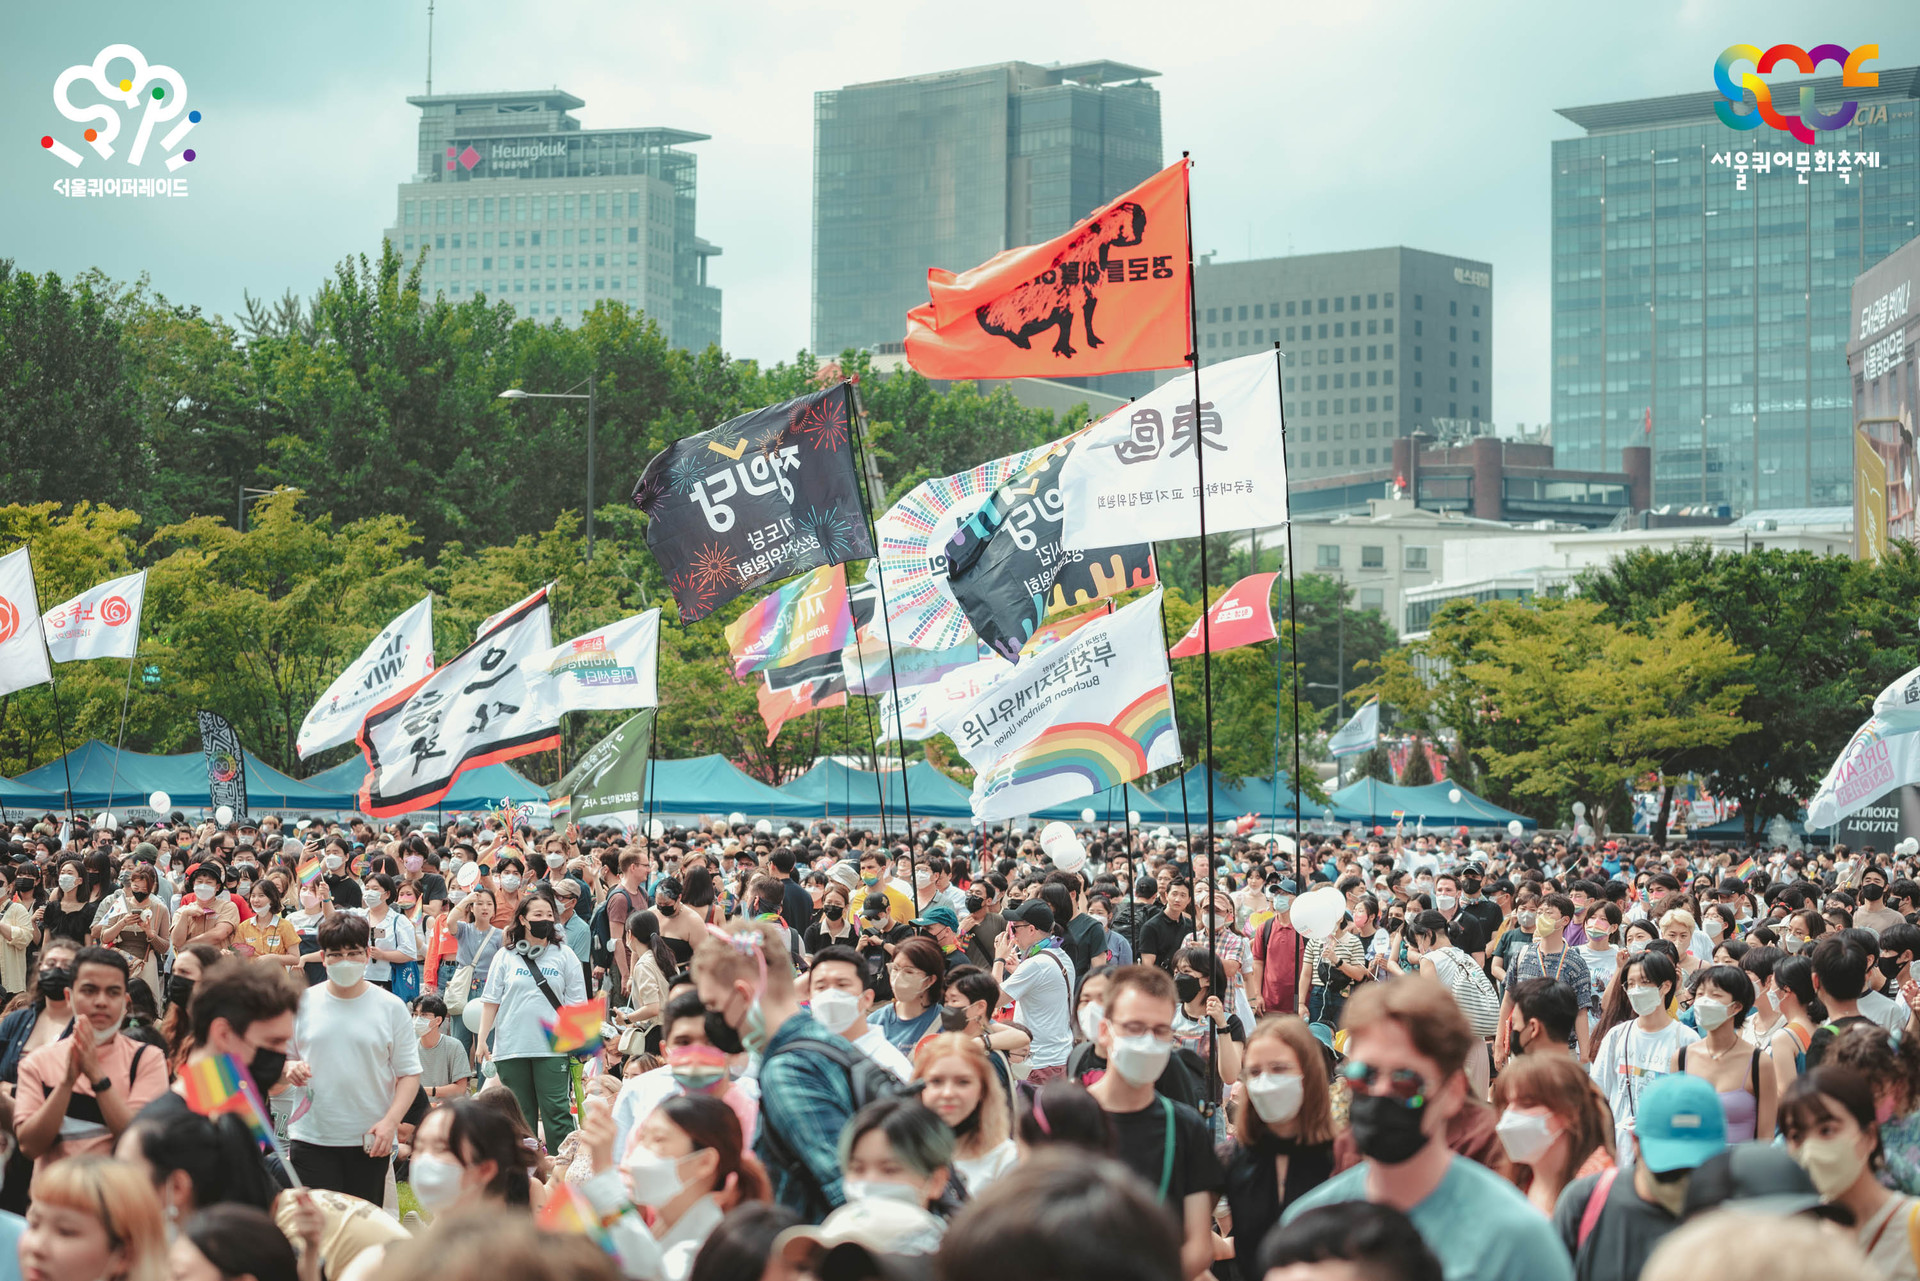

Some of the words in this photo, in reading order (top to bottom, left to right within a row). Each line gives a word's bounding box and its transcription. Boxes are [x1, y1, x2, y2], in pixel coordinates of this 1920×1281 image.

[492, 141, 566, 160] Heungkuk
[1860, 295, 1887, 341] 도서관을
[1888, 280, 1910, 324] 벗어나
[515, 967, 559, 977] Royllife
